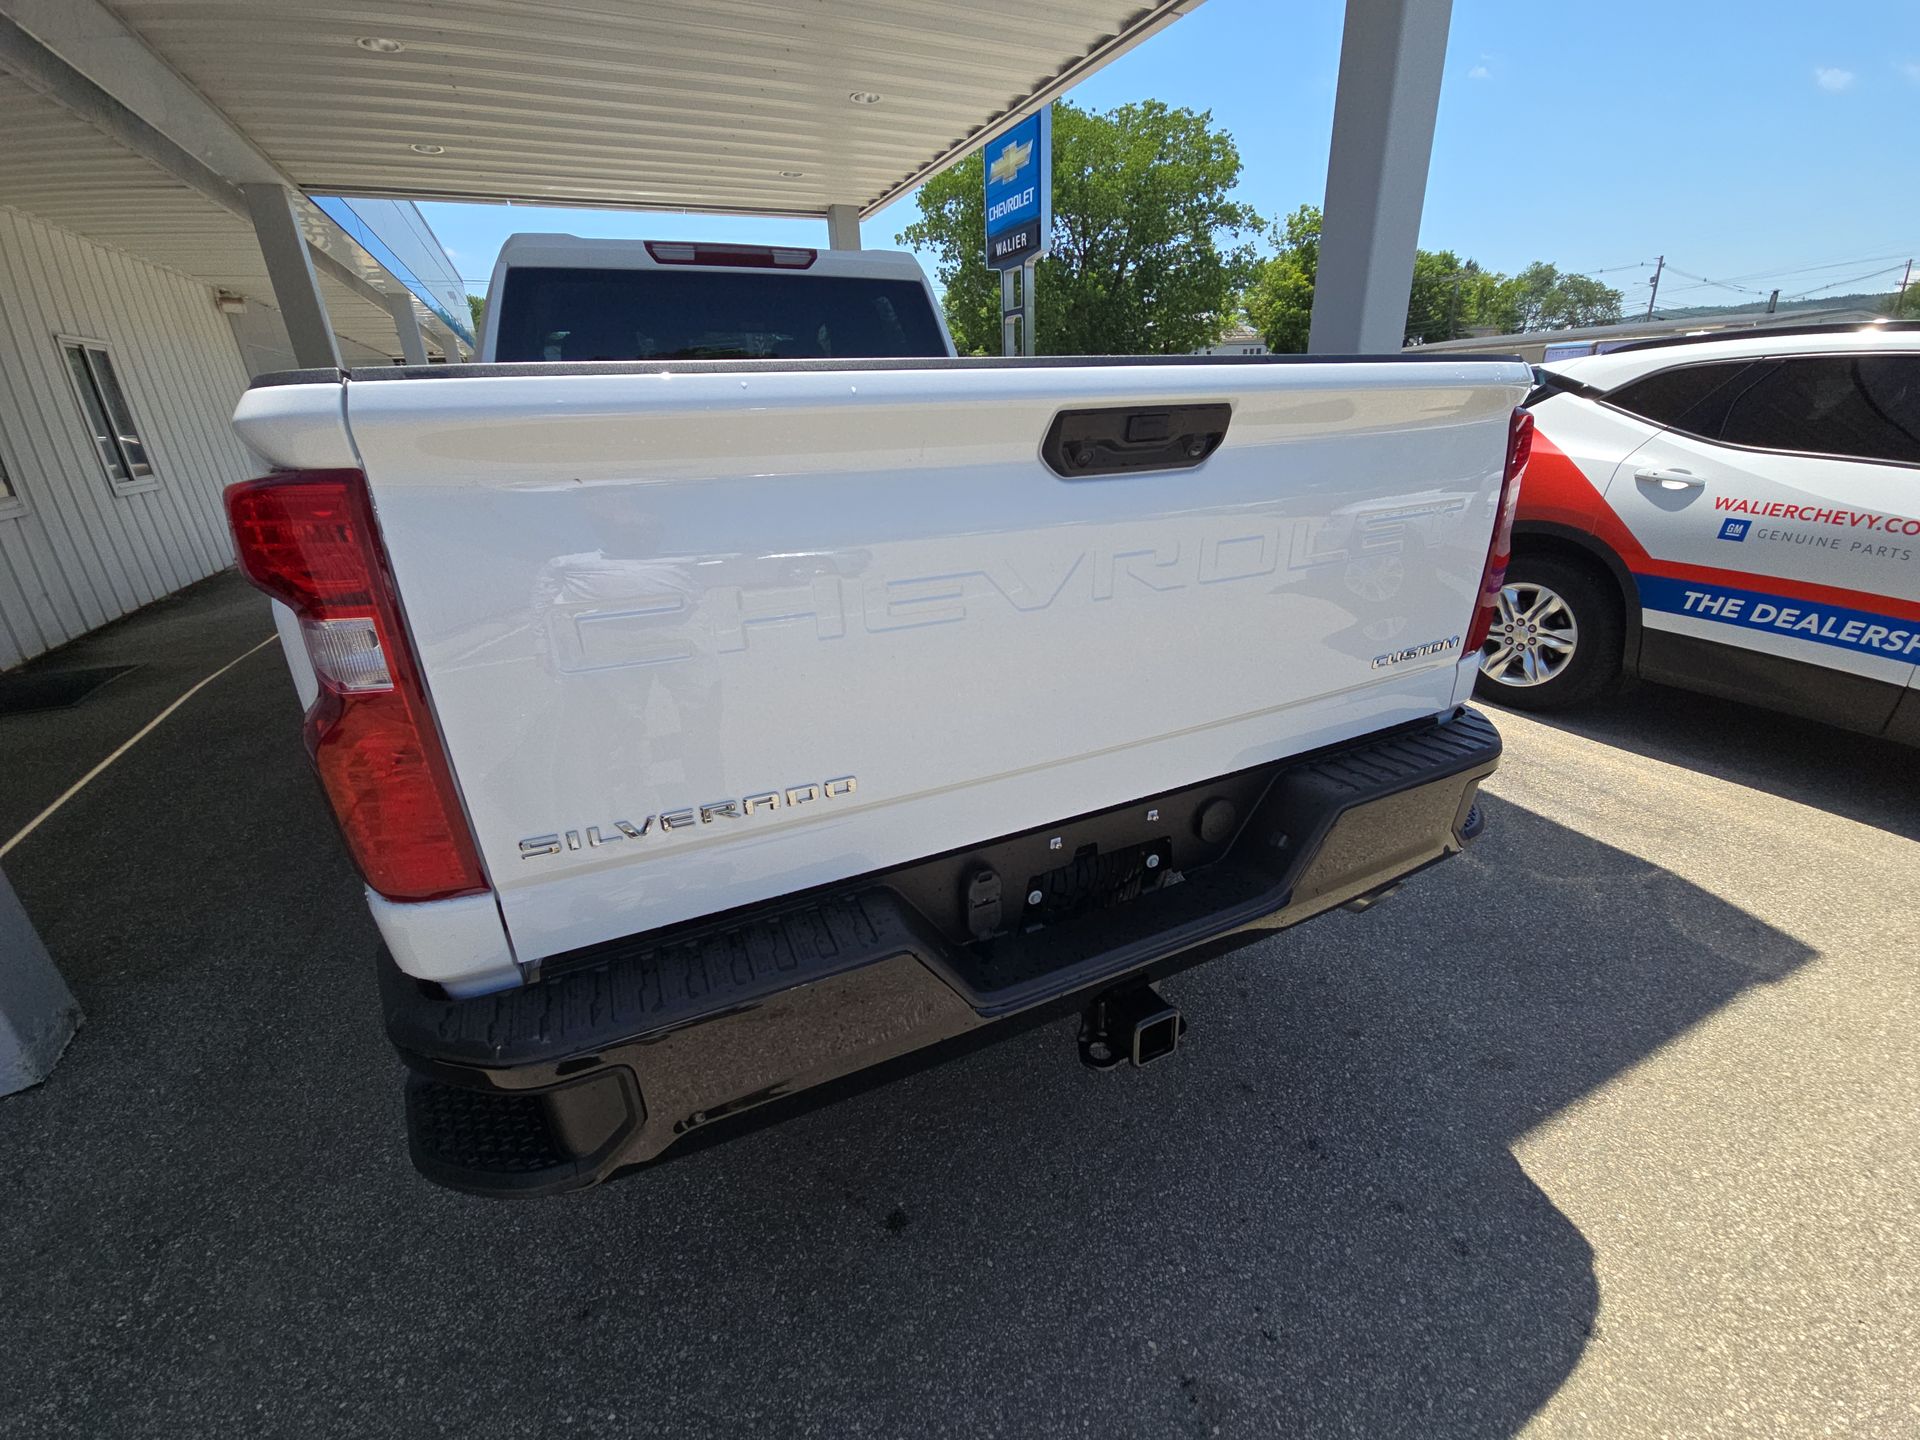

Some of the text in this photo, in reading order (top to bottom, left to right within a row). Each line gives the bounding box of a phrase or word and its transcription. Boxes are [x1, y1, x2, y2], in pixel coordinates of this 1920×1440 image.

[989, 187, 1034, 221] CHEVROLET
[996, 232, 1027, 256] WALIER
[1726, 523, 1744, 536] GM
[1757, 528, 1913, 561] GENUINE PARTS
[550, 496, 1466, 675] CHEVROLET
[1683, 591, 1745, 618] THE
[1371, 635, 1460, 669] CUSTOM
[518, 775, 857, 860] SILVERADO
